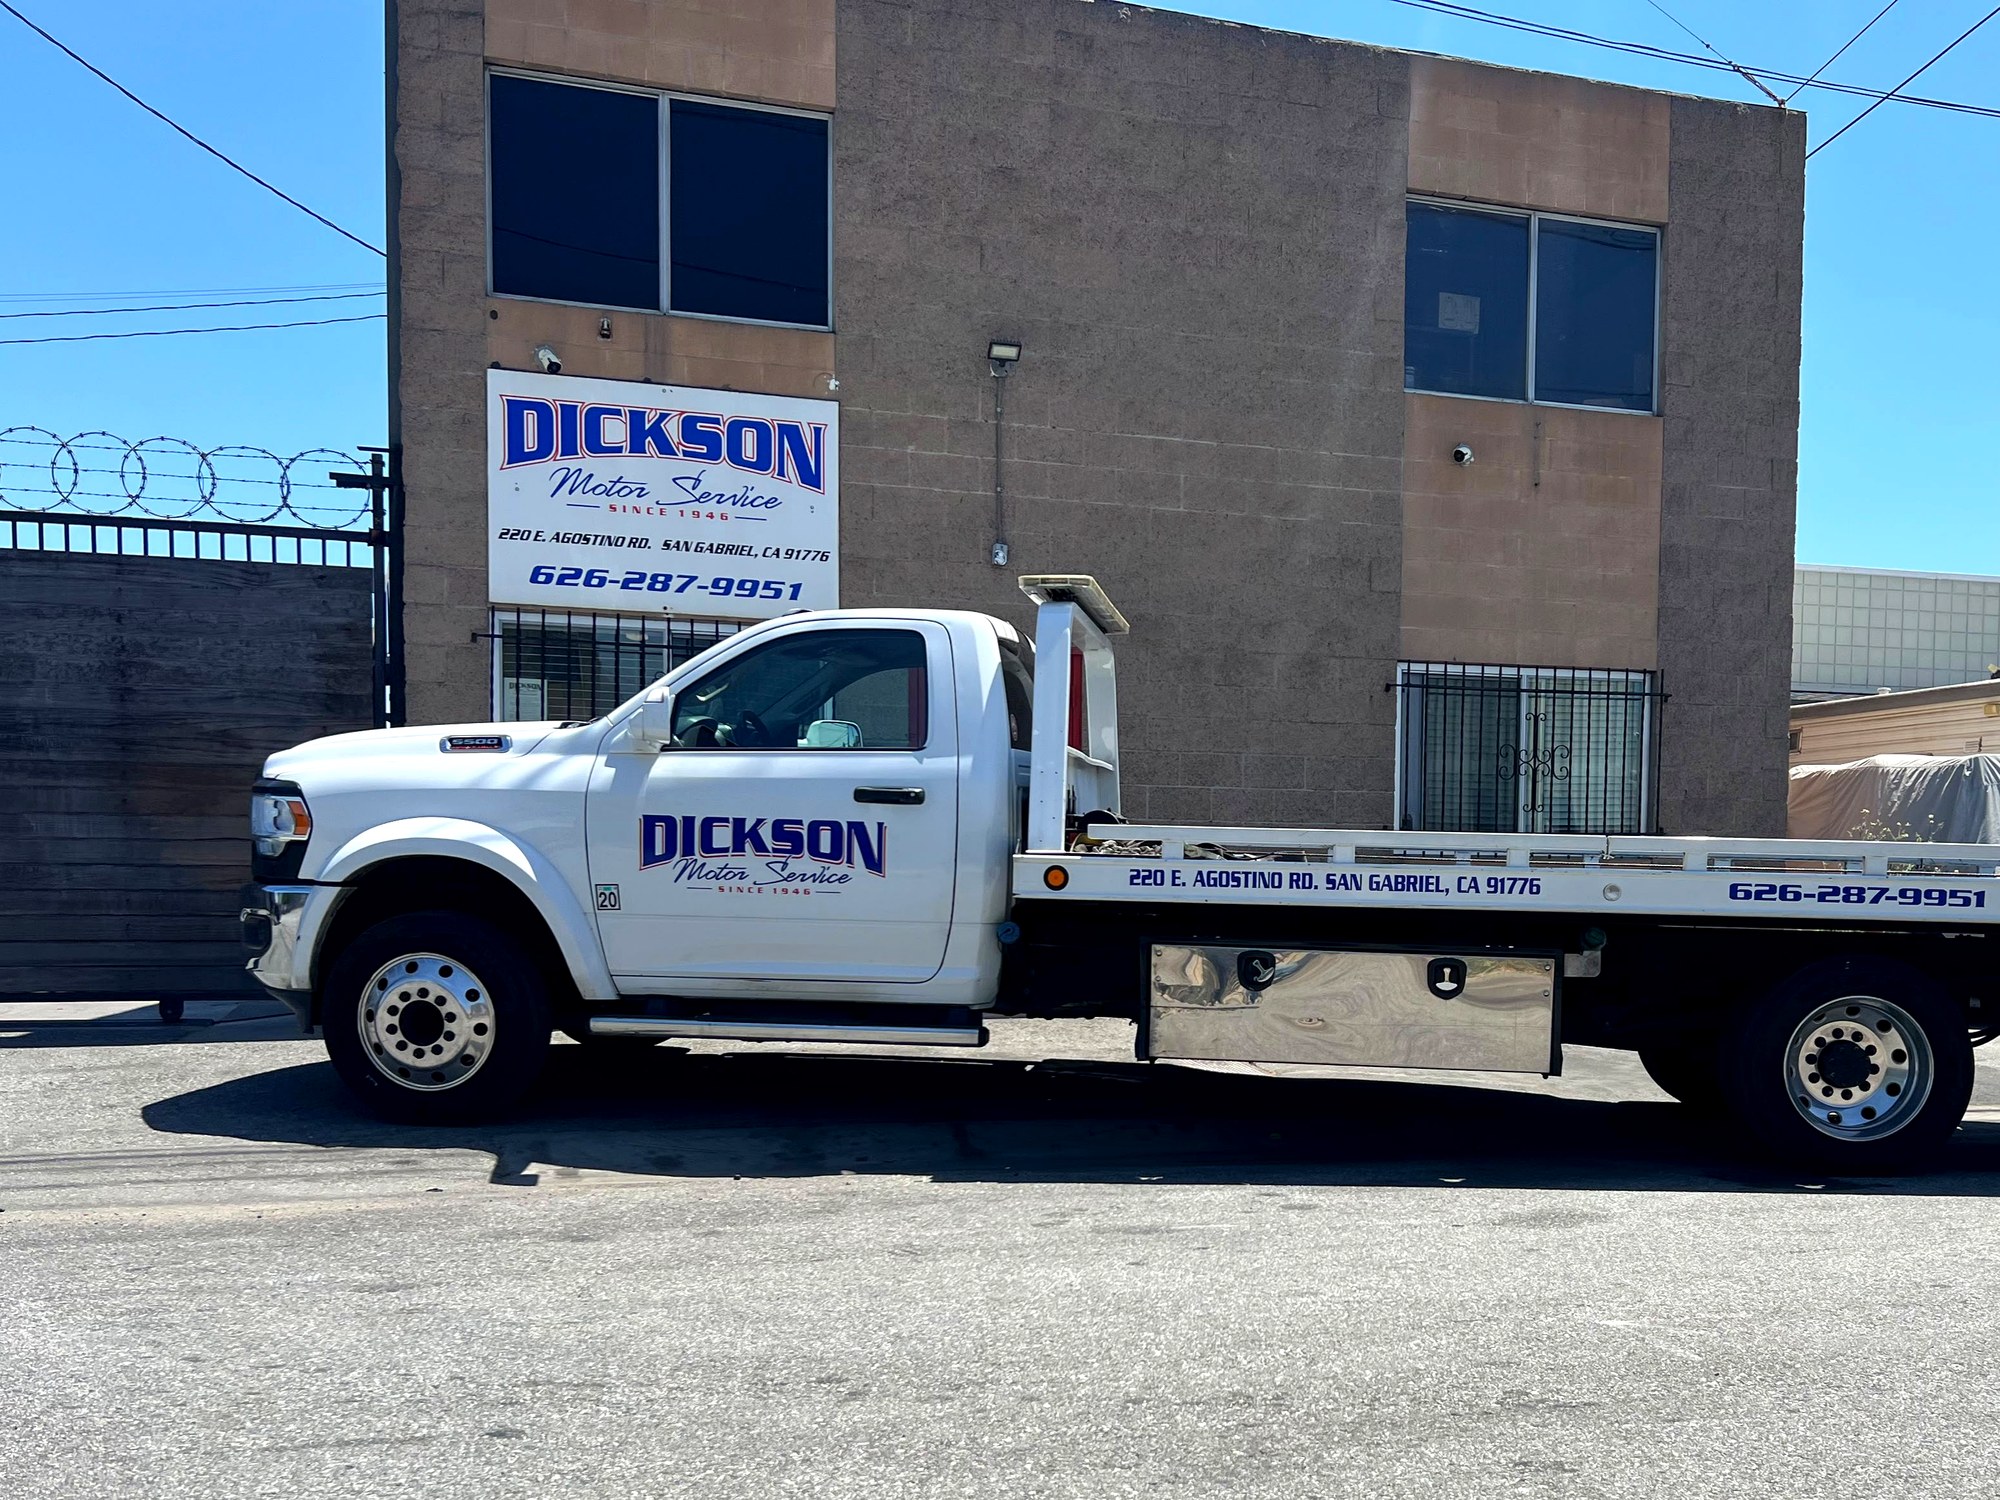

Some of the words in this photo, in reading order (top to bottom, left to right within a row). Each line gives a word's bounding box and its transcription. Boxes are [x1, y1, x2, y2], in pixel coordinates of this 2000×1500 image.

[499, 394, 828, 495] DICKSON
[549, 467, 651, 499] Motor
[655, 469, 783, 509] Service
[608, 504, 668, 516] SINCE
[678, 509, 729, 521] 1946
[498, 528, 532, 542] 220
[533, 530, 548, 543] E.
[549, 532, 625, 547] AGOSTINO
[627, 536, 652, 550] RD.
[660, 538, 694, 553] SAN
[694, 540, 759, 559] GABRIEL,
[762, 545, 782, 560] CA
[783, 547, 831, 563] 91776
[529, 564, 804, 602] 626-287-9951
[509, 682, 542, 690] DCKSON
[638, 814, 888, 878] DICKSON
[672, 857, 751, 883] Motor
[752, 855, 853, 885] Service
[1129, 869, 1165, 887] 220
[1171, 870, 1186, 887] E.
[1193, 871, 1281, 889] AGOSTINO
[1288, 872, 1319, 890] RD.
[1325, 873, 1363, 891] SAN
[1369, 874, 1450, 895] GABRIEL,
[1456, 876, 1481, 894] CA
[1486, 877, 1541, 895] 91776
[599, 891, 617, 908] 20
[718, 885, 764, 894] SINCE
[773, 887, 811, 895] 1946
[1729, 882, 1986, 908] 626-287-9951
